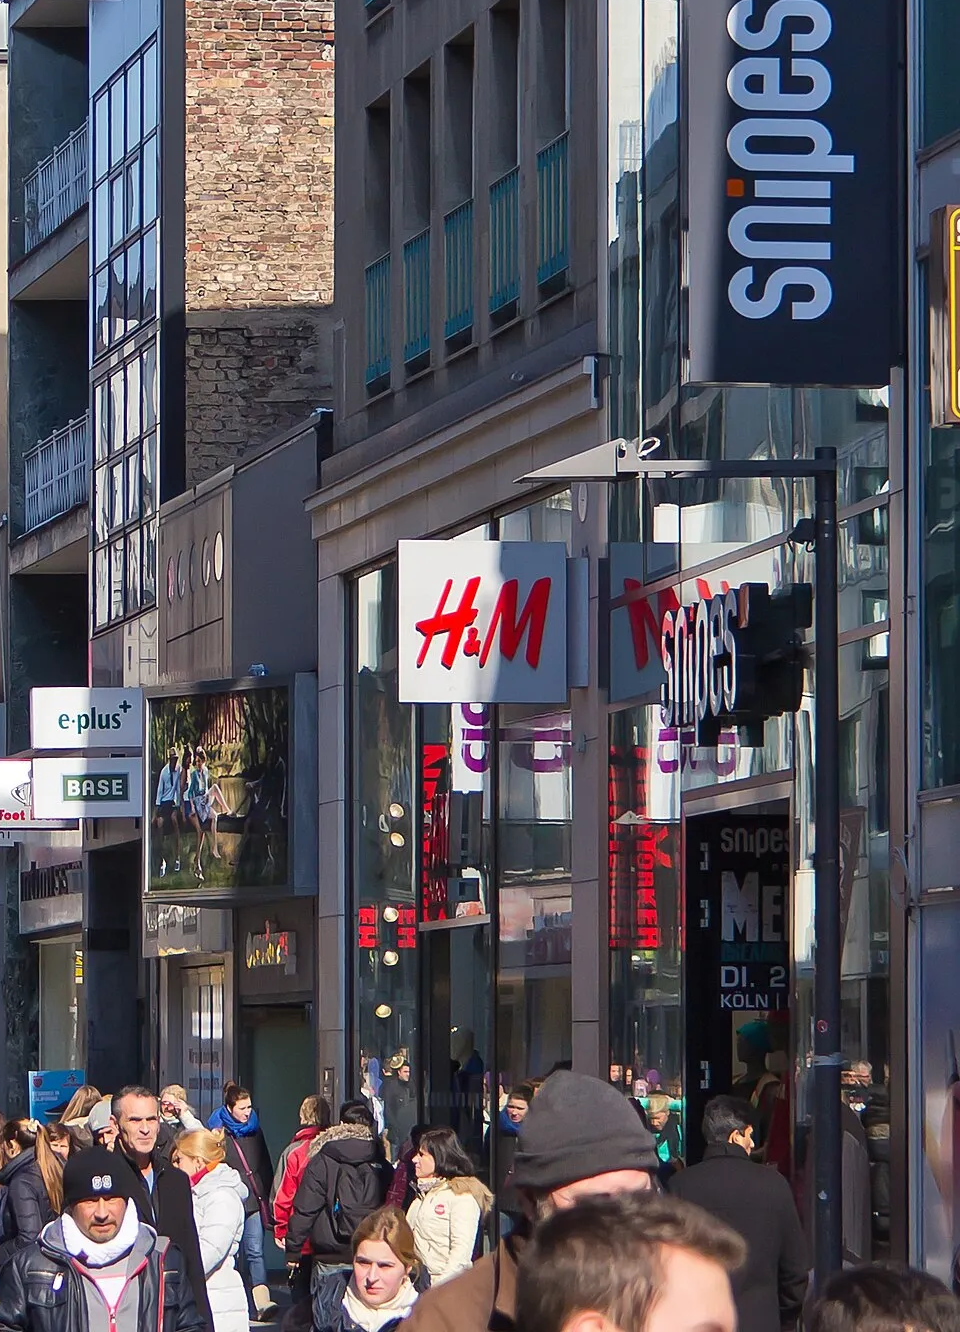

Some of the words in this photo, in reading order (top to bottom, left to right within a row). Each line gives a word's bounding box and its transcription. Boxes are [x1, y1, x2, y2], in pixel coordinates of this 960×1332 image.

[416, 576, 552, 671] H&M
[660, 588, 738, 748] snipes
[66, 779, 123, 796] BASE
[721, 966, 754, 988] DI.
[721, 991, 768, 1009] KÖLN
